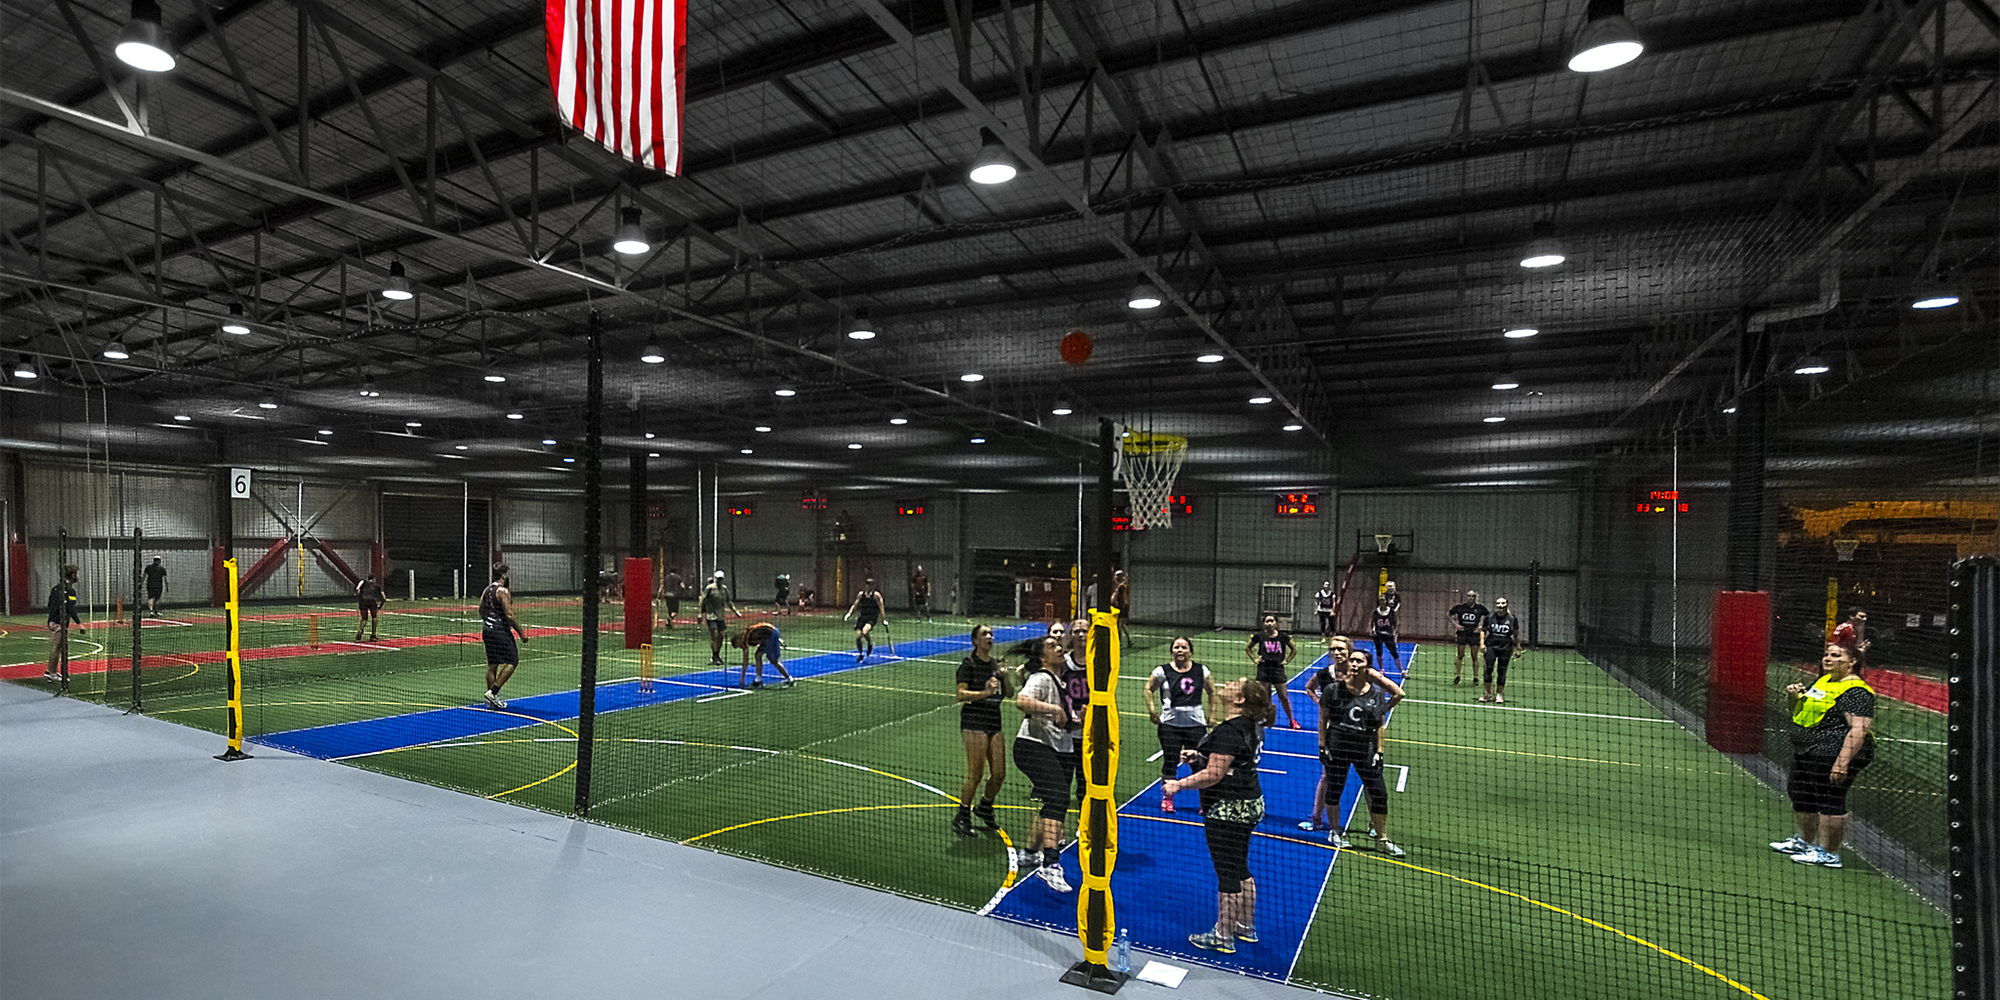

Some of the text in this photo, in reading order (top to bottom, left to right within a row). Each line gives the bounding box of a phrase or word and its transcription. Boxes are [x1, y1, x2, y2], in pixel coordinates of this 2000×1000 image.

[236, 475, 246, 494] 6
[1377, 618, 1390, 626] GA
[1462, 613, 1476, 621] GD
[1491, 624, 1510, 634] WD
[1264, 641, 1282, 653] WA
[1180, 677, 1194, 694] C
[1349, 706, 1363, 721] C
